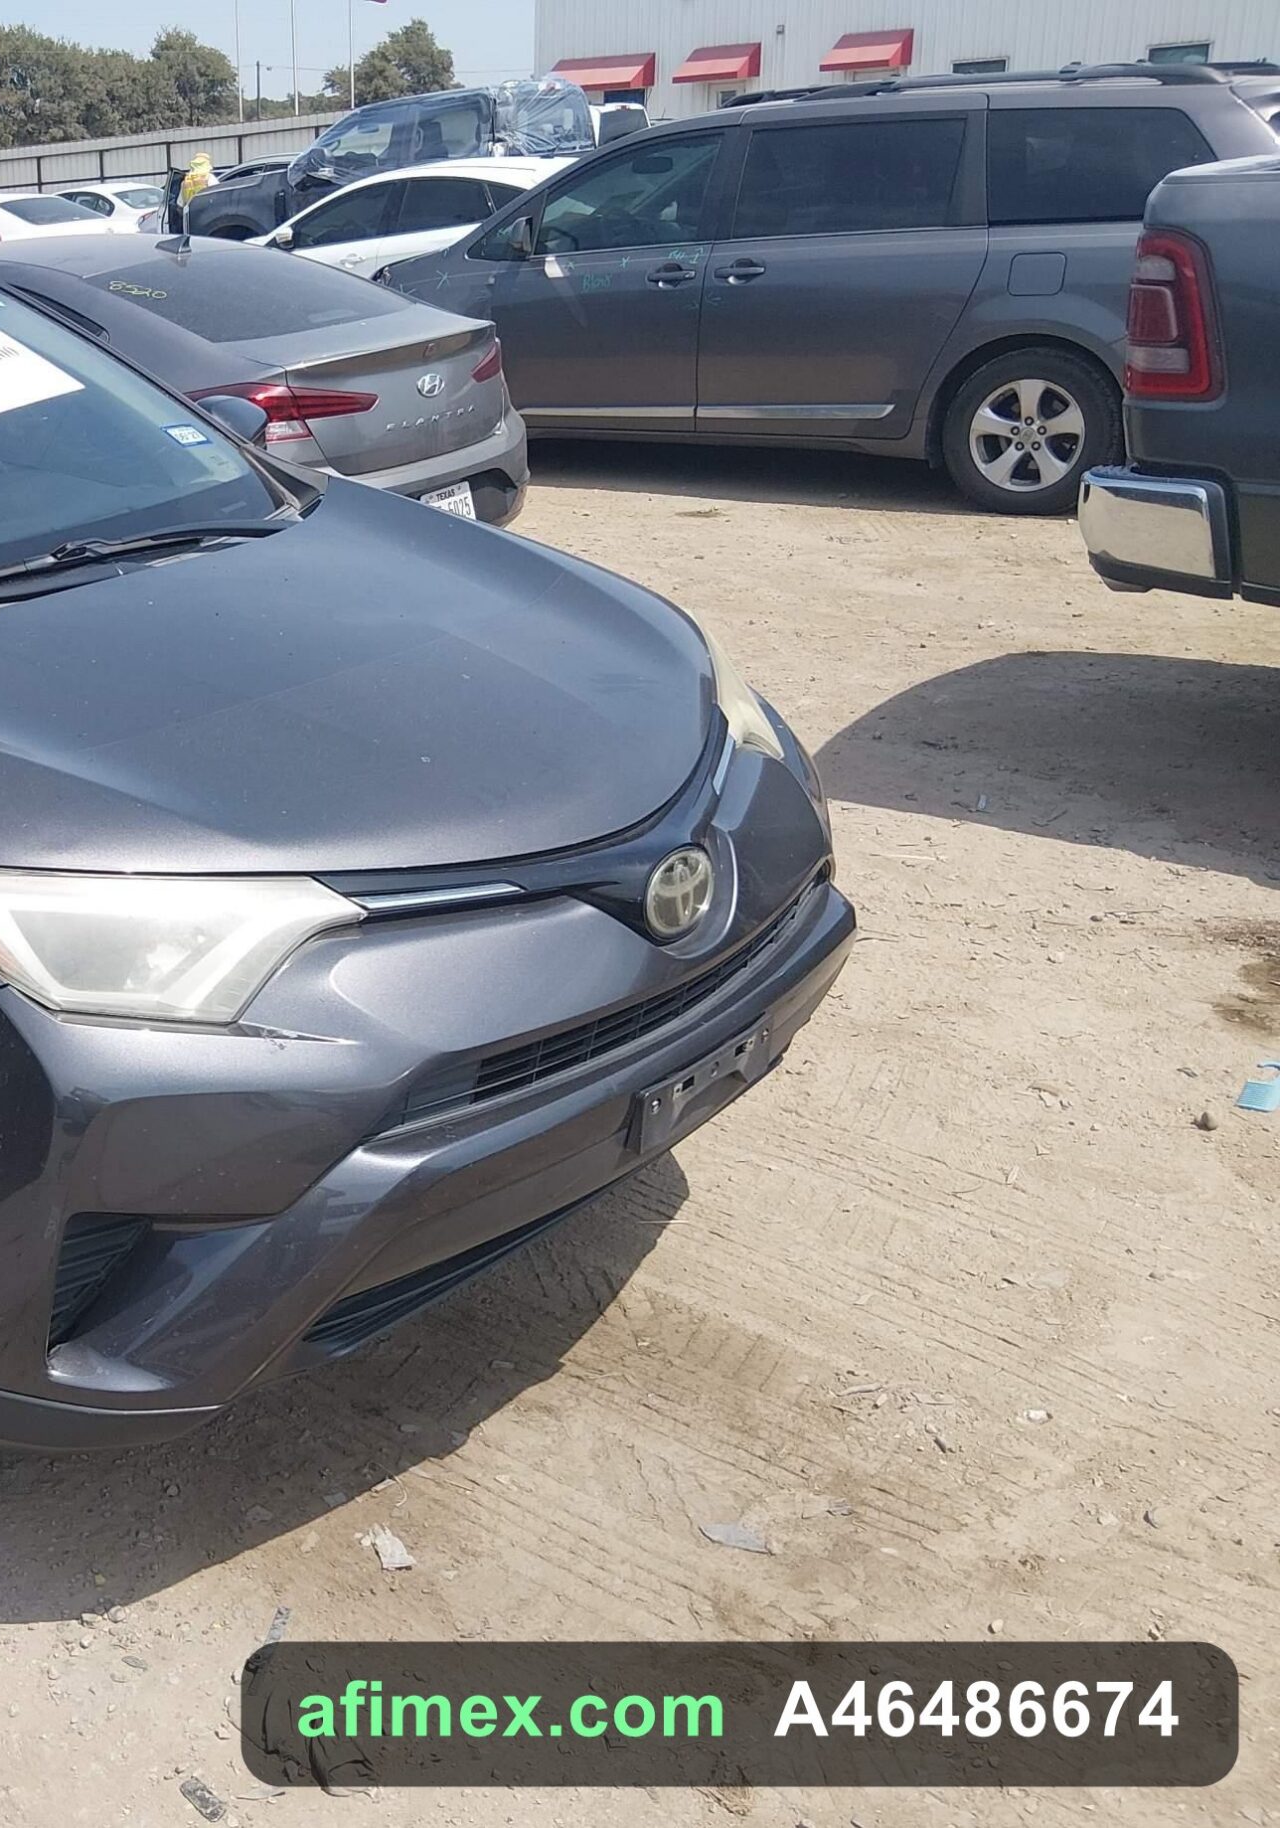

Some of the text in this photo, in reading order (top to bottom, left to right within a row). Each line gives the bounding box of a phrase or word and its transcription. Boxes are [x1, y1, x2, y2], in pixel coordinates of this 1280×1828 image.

[109, 280, 167, 299] 8520
[386, 404, 474, 431] ELANTRA
[436, 488, 456, 502] TEXAS
